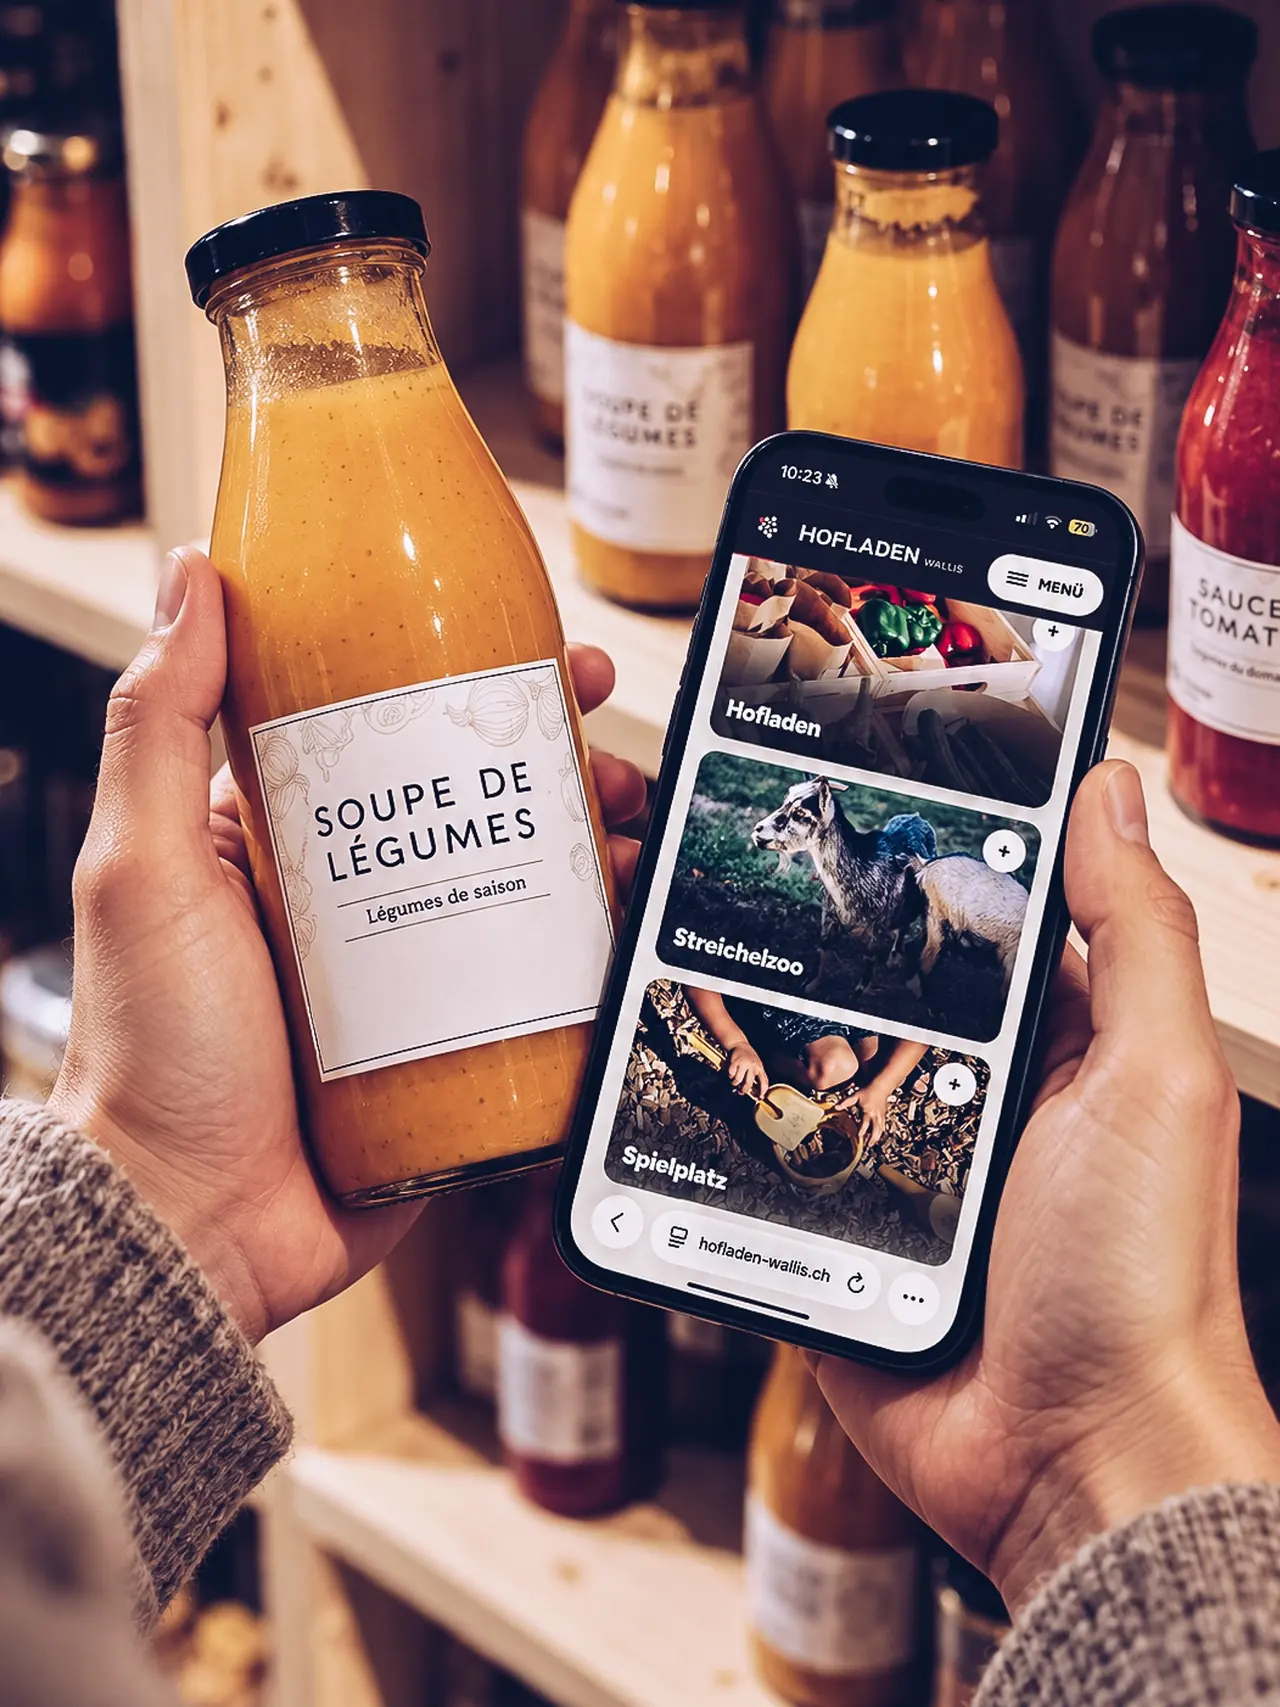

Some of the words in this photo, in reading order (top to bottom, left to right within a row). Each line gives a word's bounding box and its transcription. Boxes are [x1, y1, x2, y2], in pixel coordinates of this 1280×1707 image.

[781, 464, 823, 485] 10:23
[798, 523, 920, 565] HOFLADEN
[924, 558, 964, 574] WALLIS
[1073, 521, 1090, 534] 70
[1038, 577, 1084, 599] MENÜ
[1197, 576, 1280, 620] SAUCE
[725, 698, 822, 738] Hofladen
[314, 776, 456, 837] SOUPE
[478, 761, 532, 800] DE
[327, 808, 536, 882] LÉGUMES
[366, 895, 444, 924] Légumes
[447, 888, 469, 905] de
[474, 878, 527, 900] saison
[672, 927, 804, 977] Streichelzoo
[621, 1145, 729, 1191] Spielplatz
[698, 1236, 831, 1283] hofladen-wallis.ch
